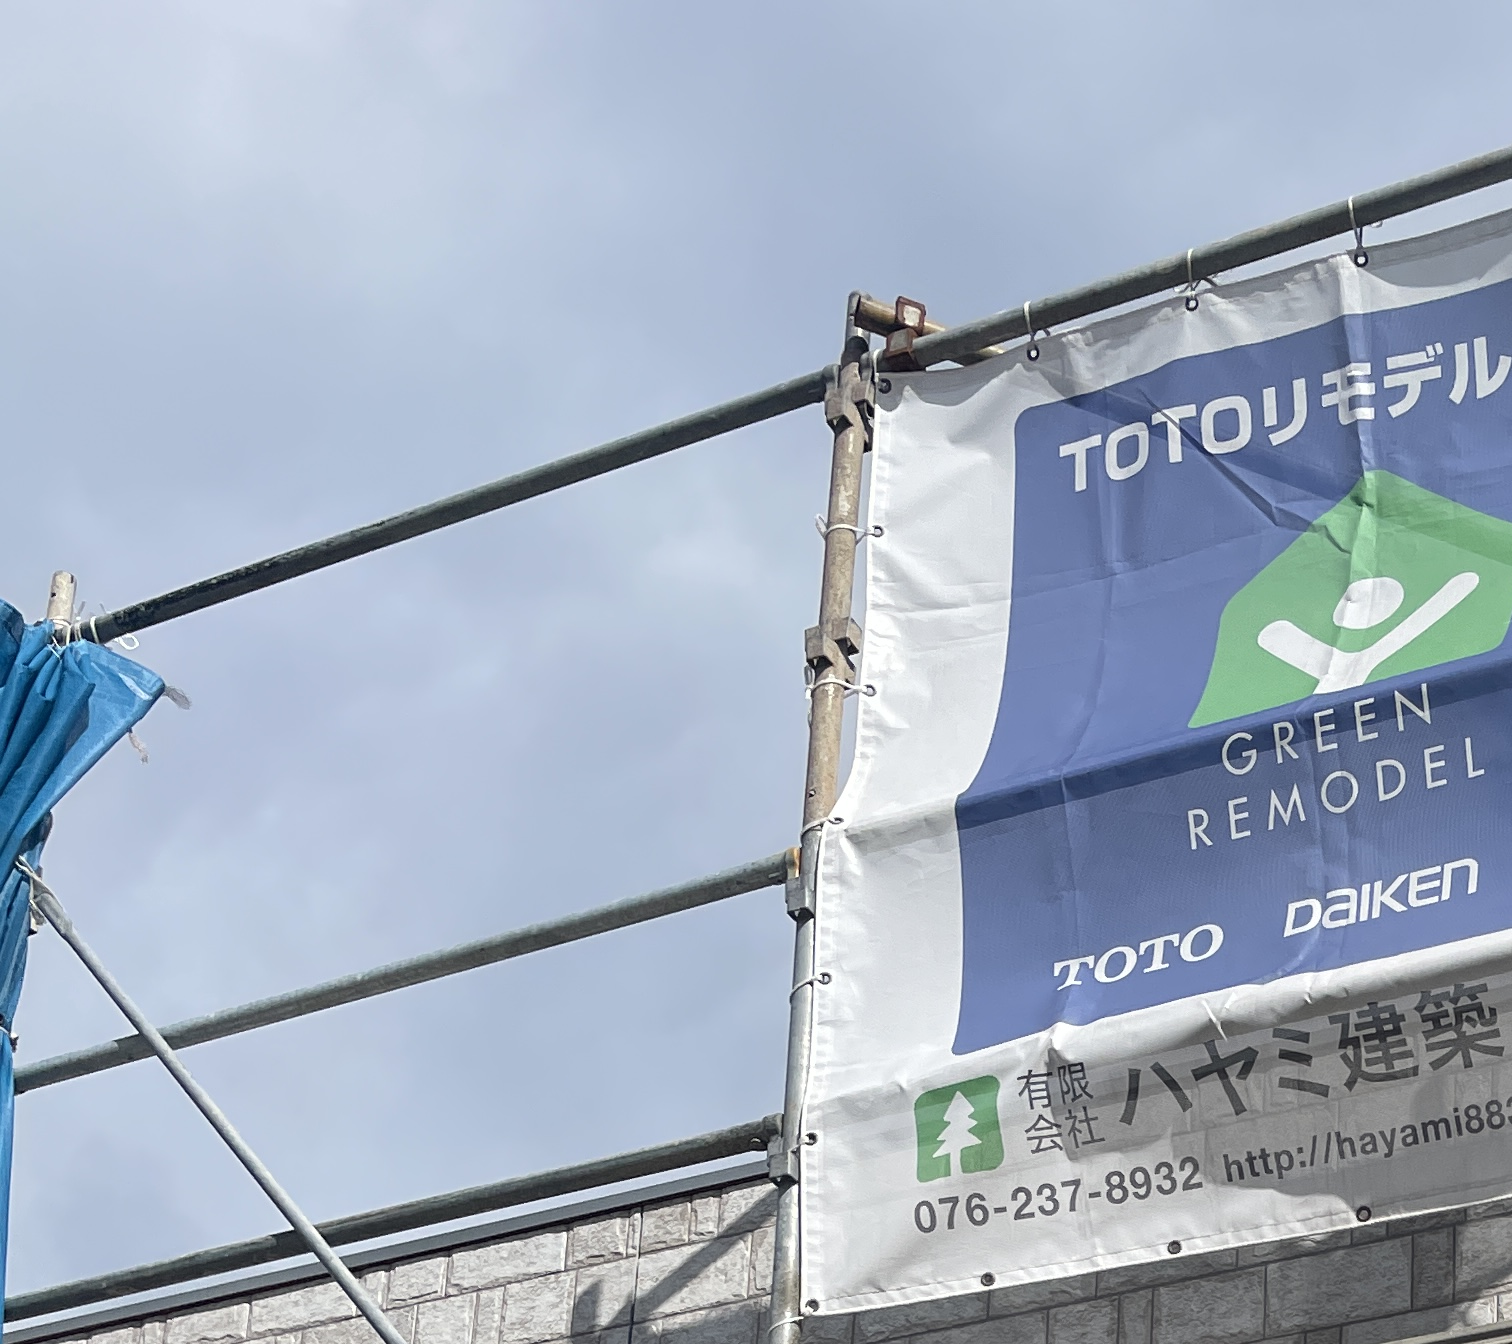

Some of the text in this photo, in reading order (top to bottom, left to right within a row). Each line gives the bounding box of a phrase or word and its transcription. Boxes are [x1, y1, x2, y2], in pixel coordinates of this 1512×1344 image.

[1222, 683, 1434, 776] GREEN
[1188, 737, 1485, 850] REMODEL
[1053, 924, 1224, 990] TOTO
[1015, 1061, 1095, 1112] 有限
[1119, 982, 1505, 1126] ハヤミ建築
[1024, 1107, 1106, 1157] 会社
[913, 1155, 1204, 1234] 076-237-8932
